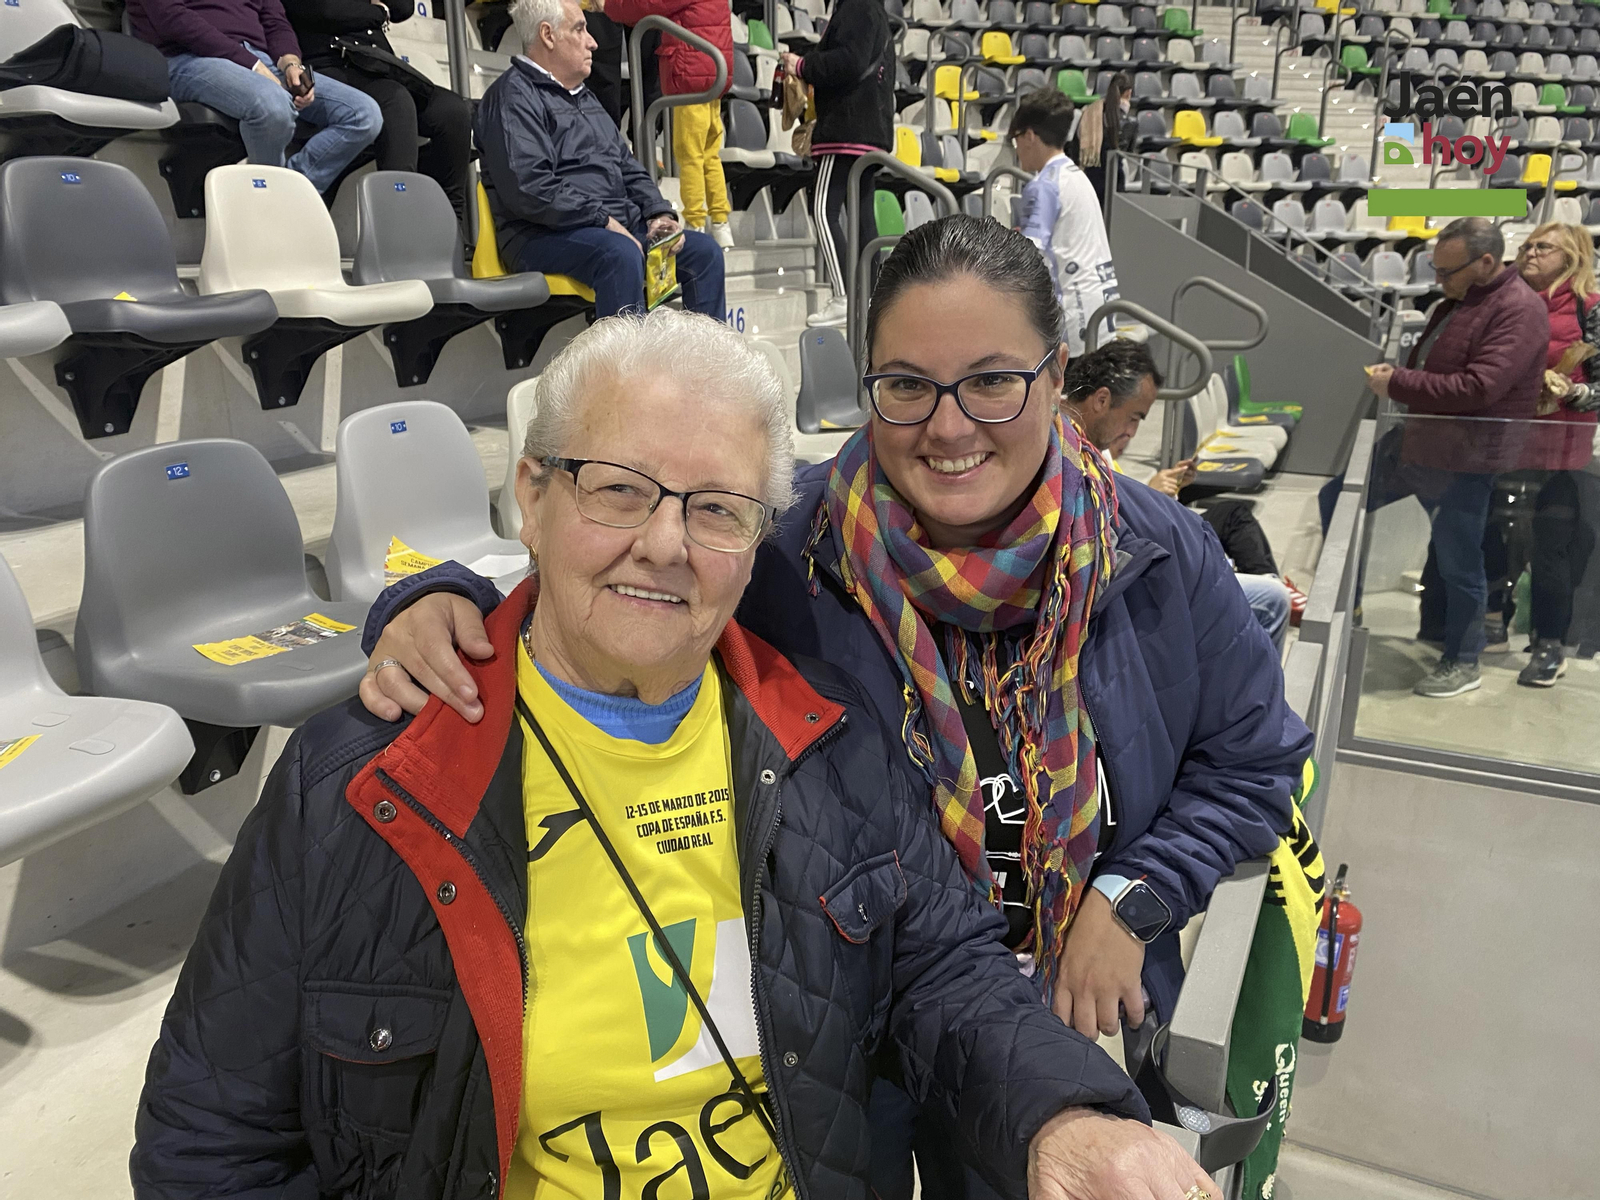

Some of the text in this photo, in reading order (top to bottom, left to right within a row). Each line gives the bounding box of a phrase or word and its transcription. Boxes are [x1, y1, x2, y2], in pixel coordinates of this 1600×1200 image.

[727, 307, 745, 333] 16
[173, 466, 183, 475] 12
[625, 788, 729, 819] 12-15 DE MARZO DE 2015
[636, 809, 727, 838] COPA DE ESPAÑA F.S.
[656, 832, 713, 854] CIUDAD REAL
[1275, 1041, 1296, 1123] Queen
[538, 1077, 776, 1200] Jaé
